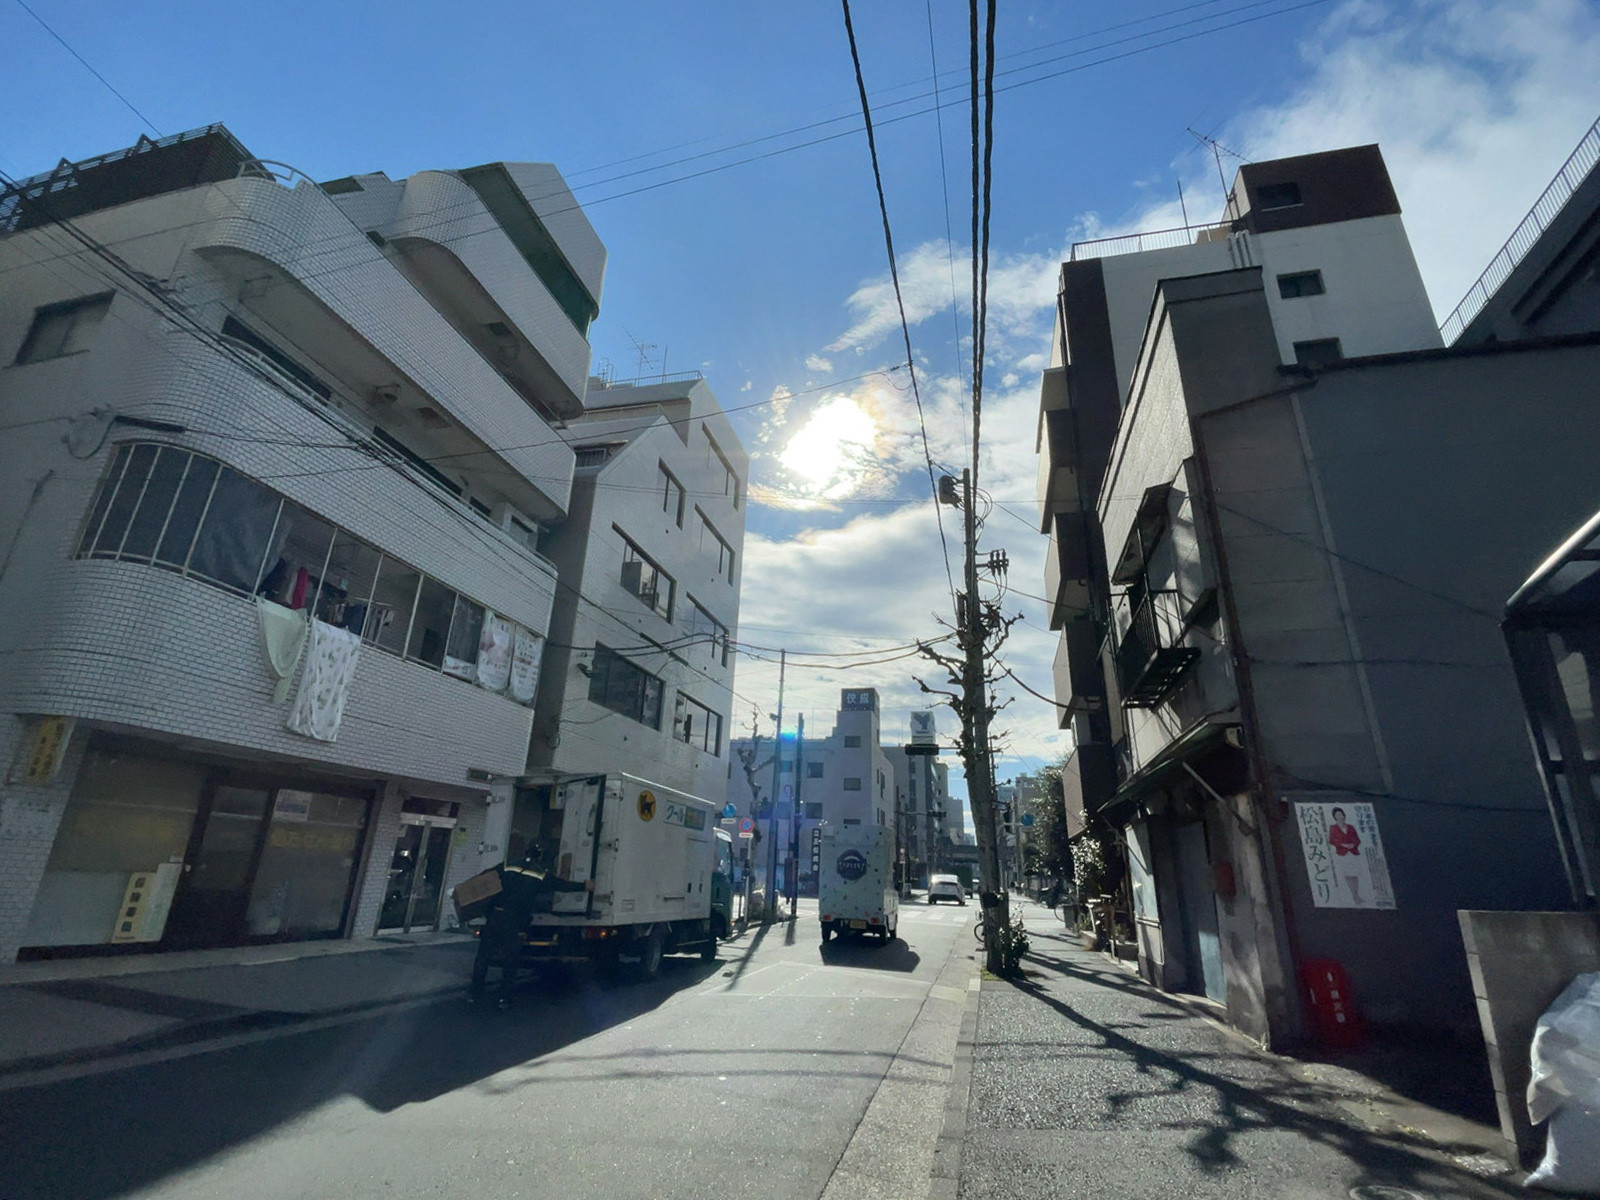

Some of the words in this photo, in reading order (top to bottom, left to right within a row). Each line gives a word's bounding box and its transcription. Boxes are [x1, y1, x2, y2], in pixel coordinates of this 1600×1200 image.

[1299, 805, 1331, 905] 松島みどり
